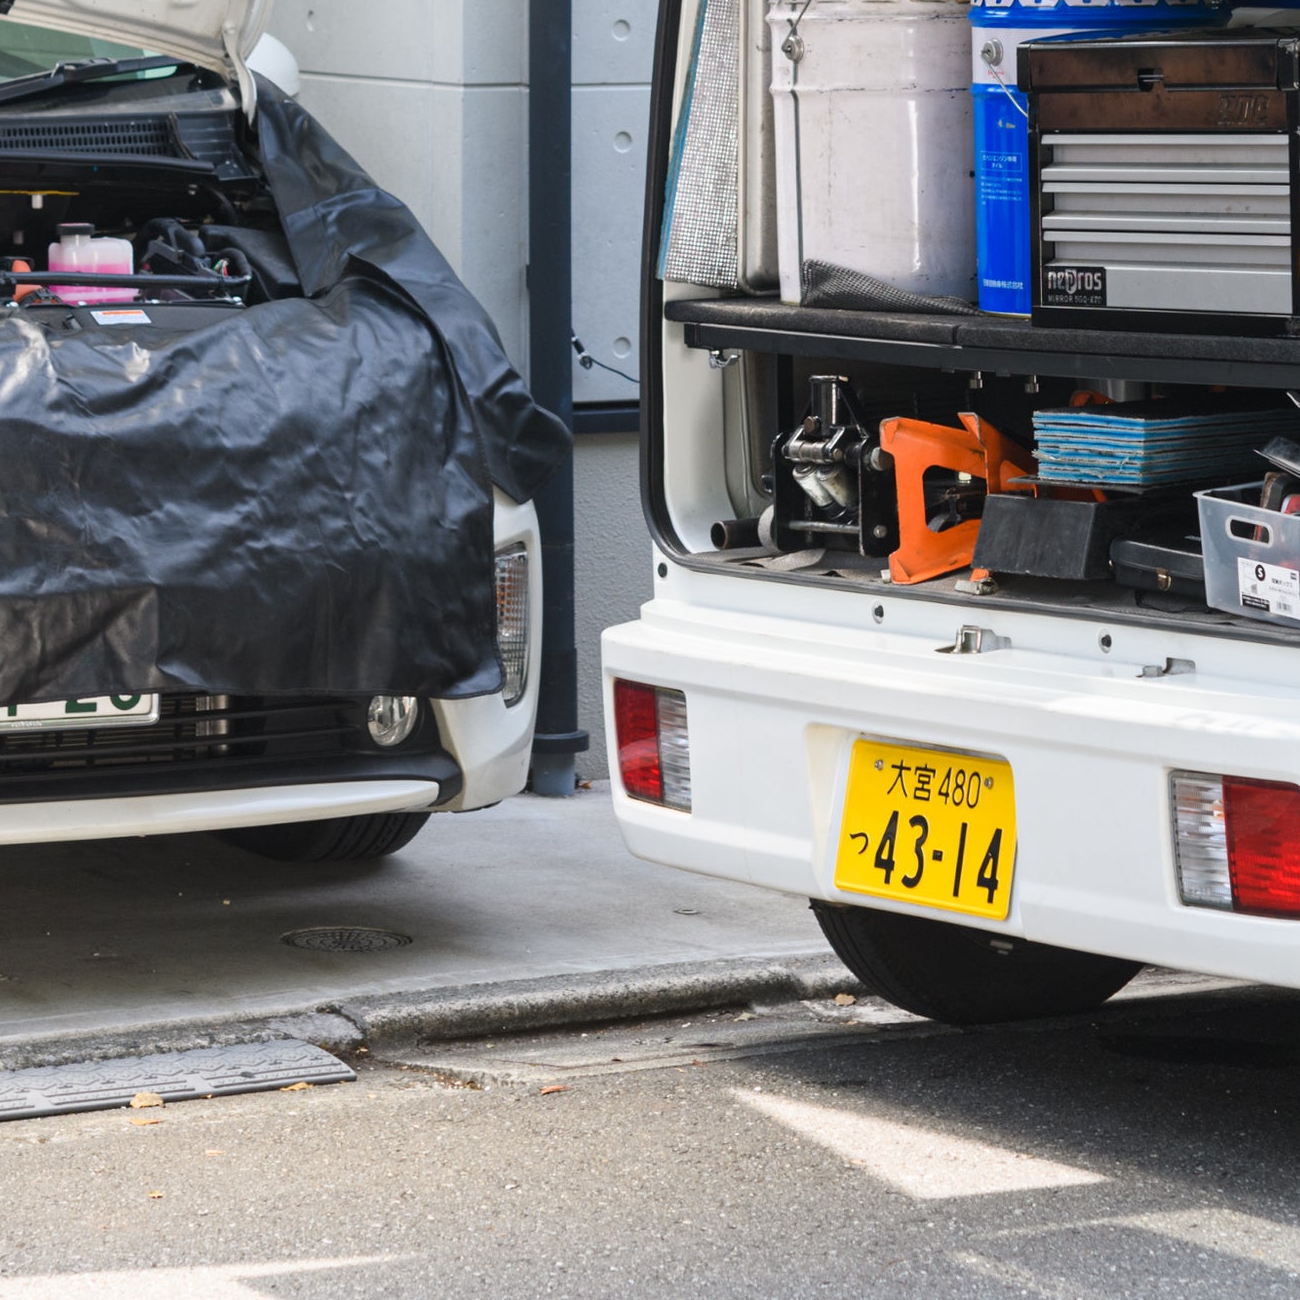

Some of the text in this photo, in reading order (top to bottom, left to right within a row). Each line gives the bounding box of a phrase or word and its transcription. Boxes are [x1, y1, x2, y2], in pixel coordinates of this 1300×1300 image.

[1047, 269, 1103, 295] nepros
[849, 809, 1003, 905] つ 43-14
